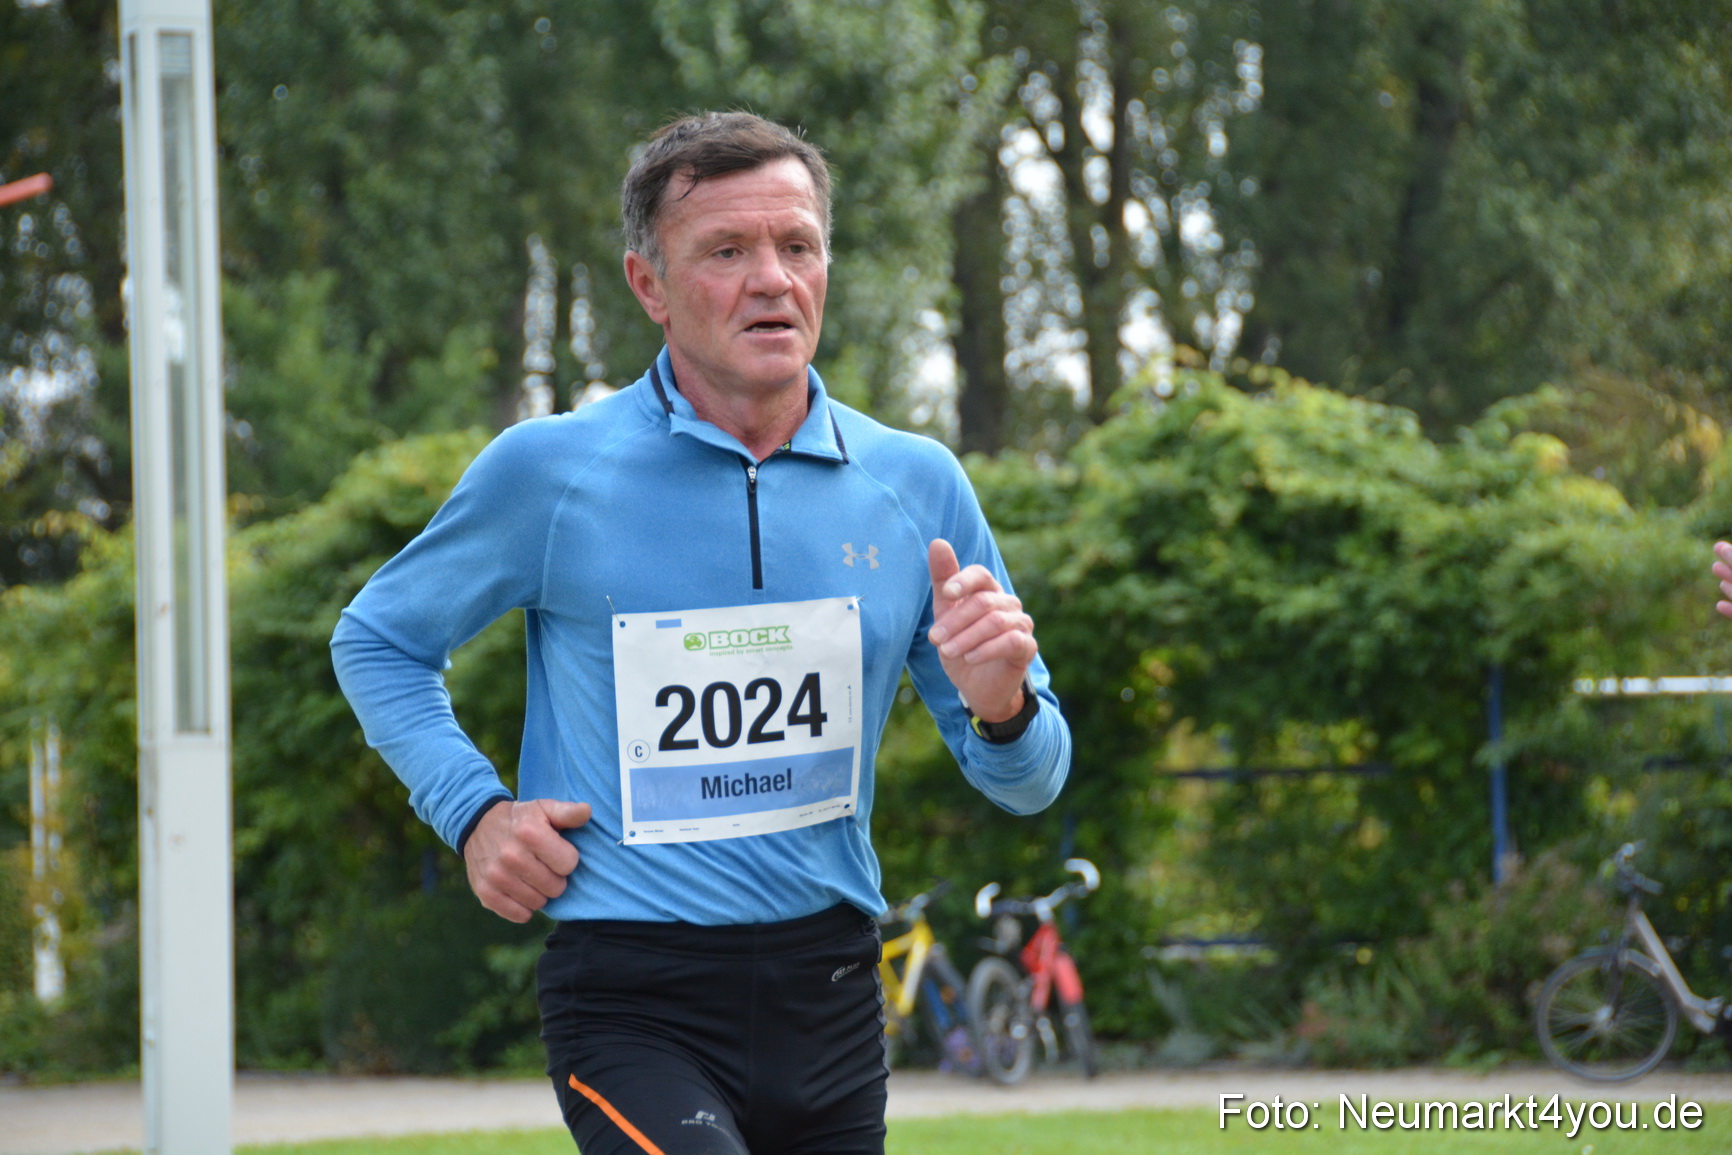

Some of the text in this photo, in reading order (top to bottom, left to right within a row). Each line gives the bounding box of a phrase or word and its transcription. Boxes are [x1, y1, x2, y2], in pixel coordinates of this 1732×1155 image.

[708, 625, 792, 650] BOCK
[709, 644, 793, 657] inspired by smart concepts
[655, 672, 828, 752] 2024
[634, 745, 643, 758] C
[701, 768, 793, 800] Michael
